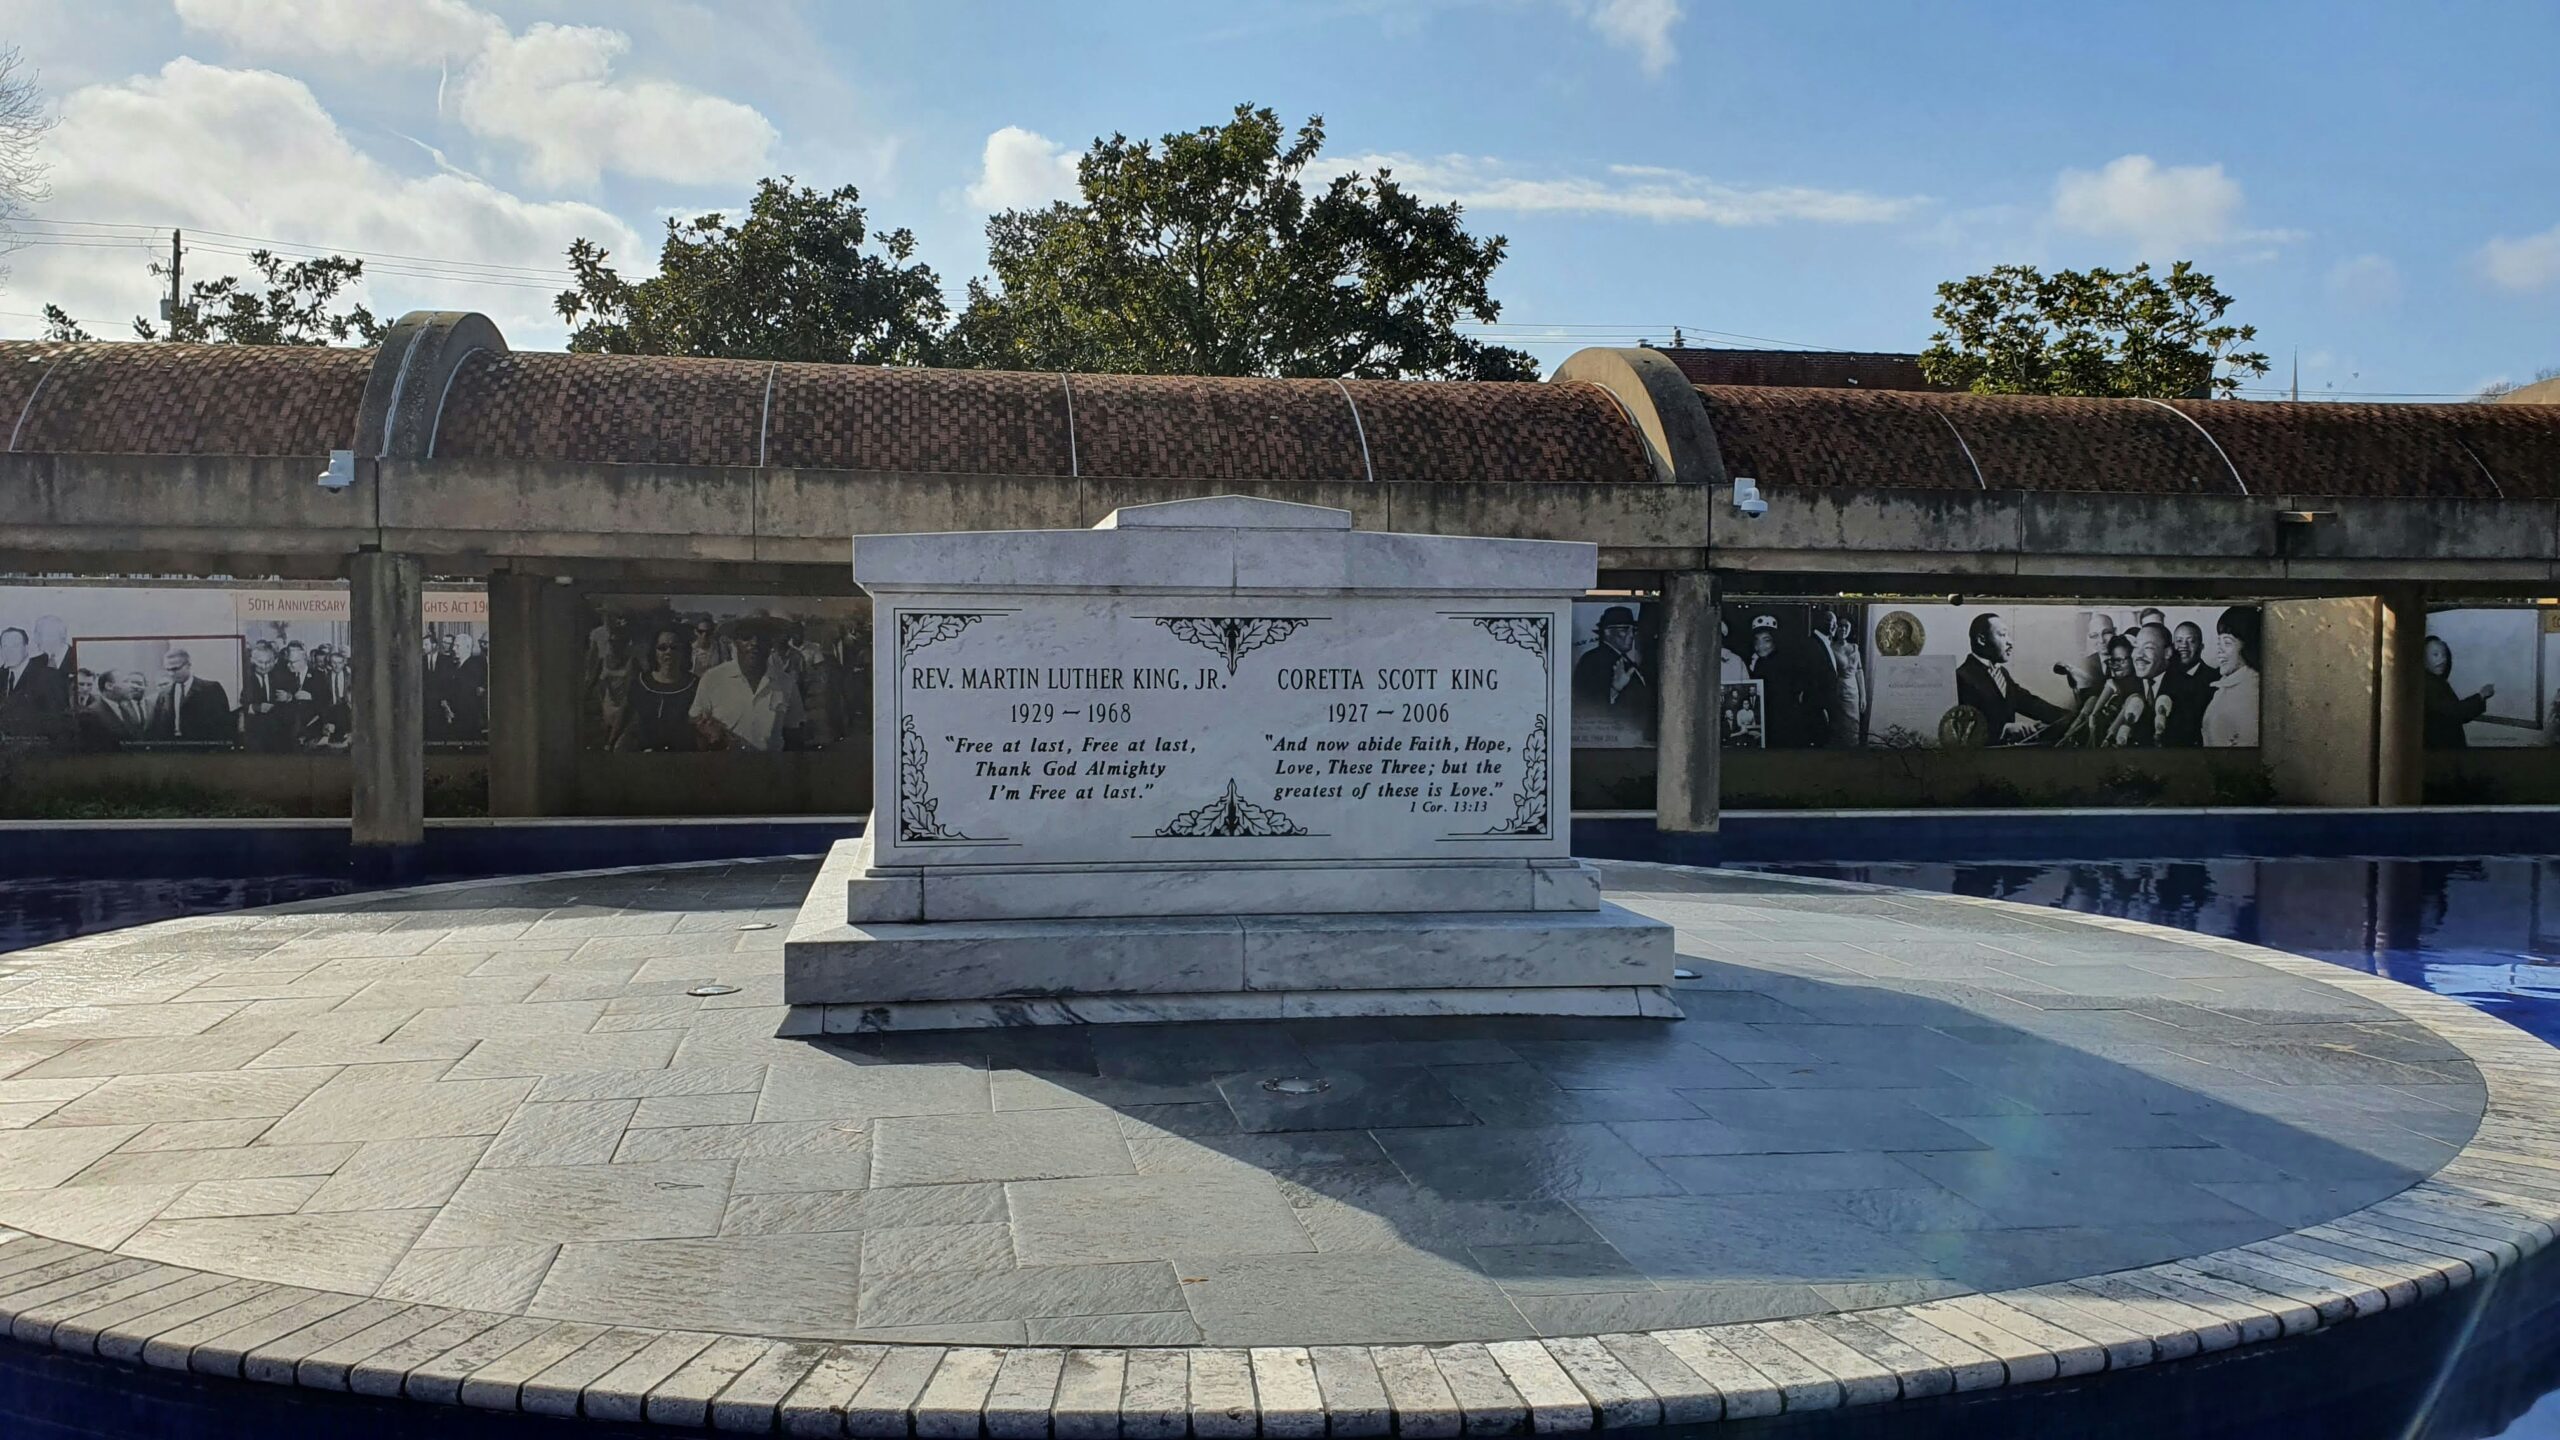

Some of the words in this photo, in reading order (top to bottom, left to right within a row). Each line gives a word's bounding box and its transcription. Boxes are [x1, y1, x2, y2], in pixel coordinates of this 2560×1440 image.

[248, 598, 275, 611] 50TH
[277, 598, 346, 612] ANNIVERSARY
[423, 600, 449, 613] GHTS
[451, 600, 469, 613] ACT
[472, 600, 488, 613] 19
[911, 667, 954, 690] REV.
[961, 667, 1040, 690] MARTIN
[1047, 667, 1125, 690] LUTHER
[1133, 667, 1188, 691] KING,
[1194, 668, 1227, 691] JR.
[1277, 668, 1365, 691] CORETTA
[1377, 668, 1438, 691] SCOTT
[1450, 668, 1499, 691] KING
[1011, 702, 1054, 724] 1929
[1088, 702, 1131, 724] 1968
[1328, 702, 1369, 724] 1927
[1401, 702, 1450, 724] 2006
[1002, 739, 1021, 753] at
[1030, 737, 1072, 755] last,
[1081, 736, 1119, 753] Free
[1127, 738, 1146, 752] at
[1154, 736, 1196, 754] last,
[1315, 740, 1350, 752] now
[1357, 735, 1403, 752] abide
[1408, 735, 1459, 754] Faith,
[1464, 735, 1512, 754] Hope,
[975, 760, 1032, 777] Thank
[1042, 760, 1078, 777] God
[1084, 759, 1167, 780] Almighty
[1274, 759, 1321, 777] Love,
[1328, 758, 1373, 775] These
[1381, 758, 1436, 777] Three;
[1441, 758, 1468, 775] but
[1476, 758, 1502, 775] the
[988, 784, 1021, 801] I'm
[1028, 784, 1067, 801] Free
[1075, 786, 1094, 800] at
[1273, 784, 1343, 802] greatest
[1351, 781, 1372, 800] of
[1377, 782, 1420, 798] these
[1427, 781, 1443, 798] is
[1410, 801, 1417, 813] 1
[1422, 800, 1448, 813] Cor.
[1453, 800, 1488, 813] 13:13
